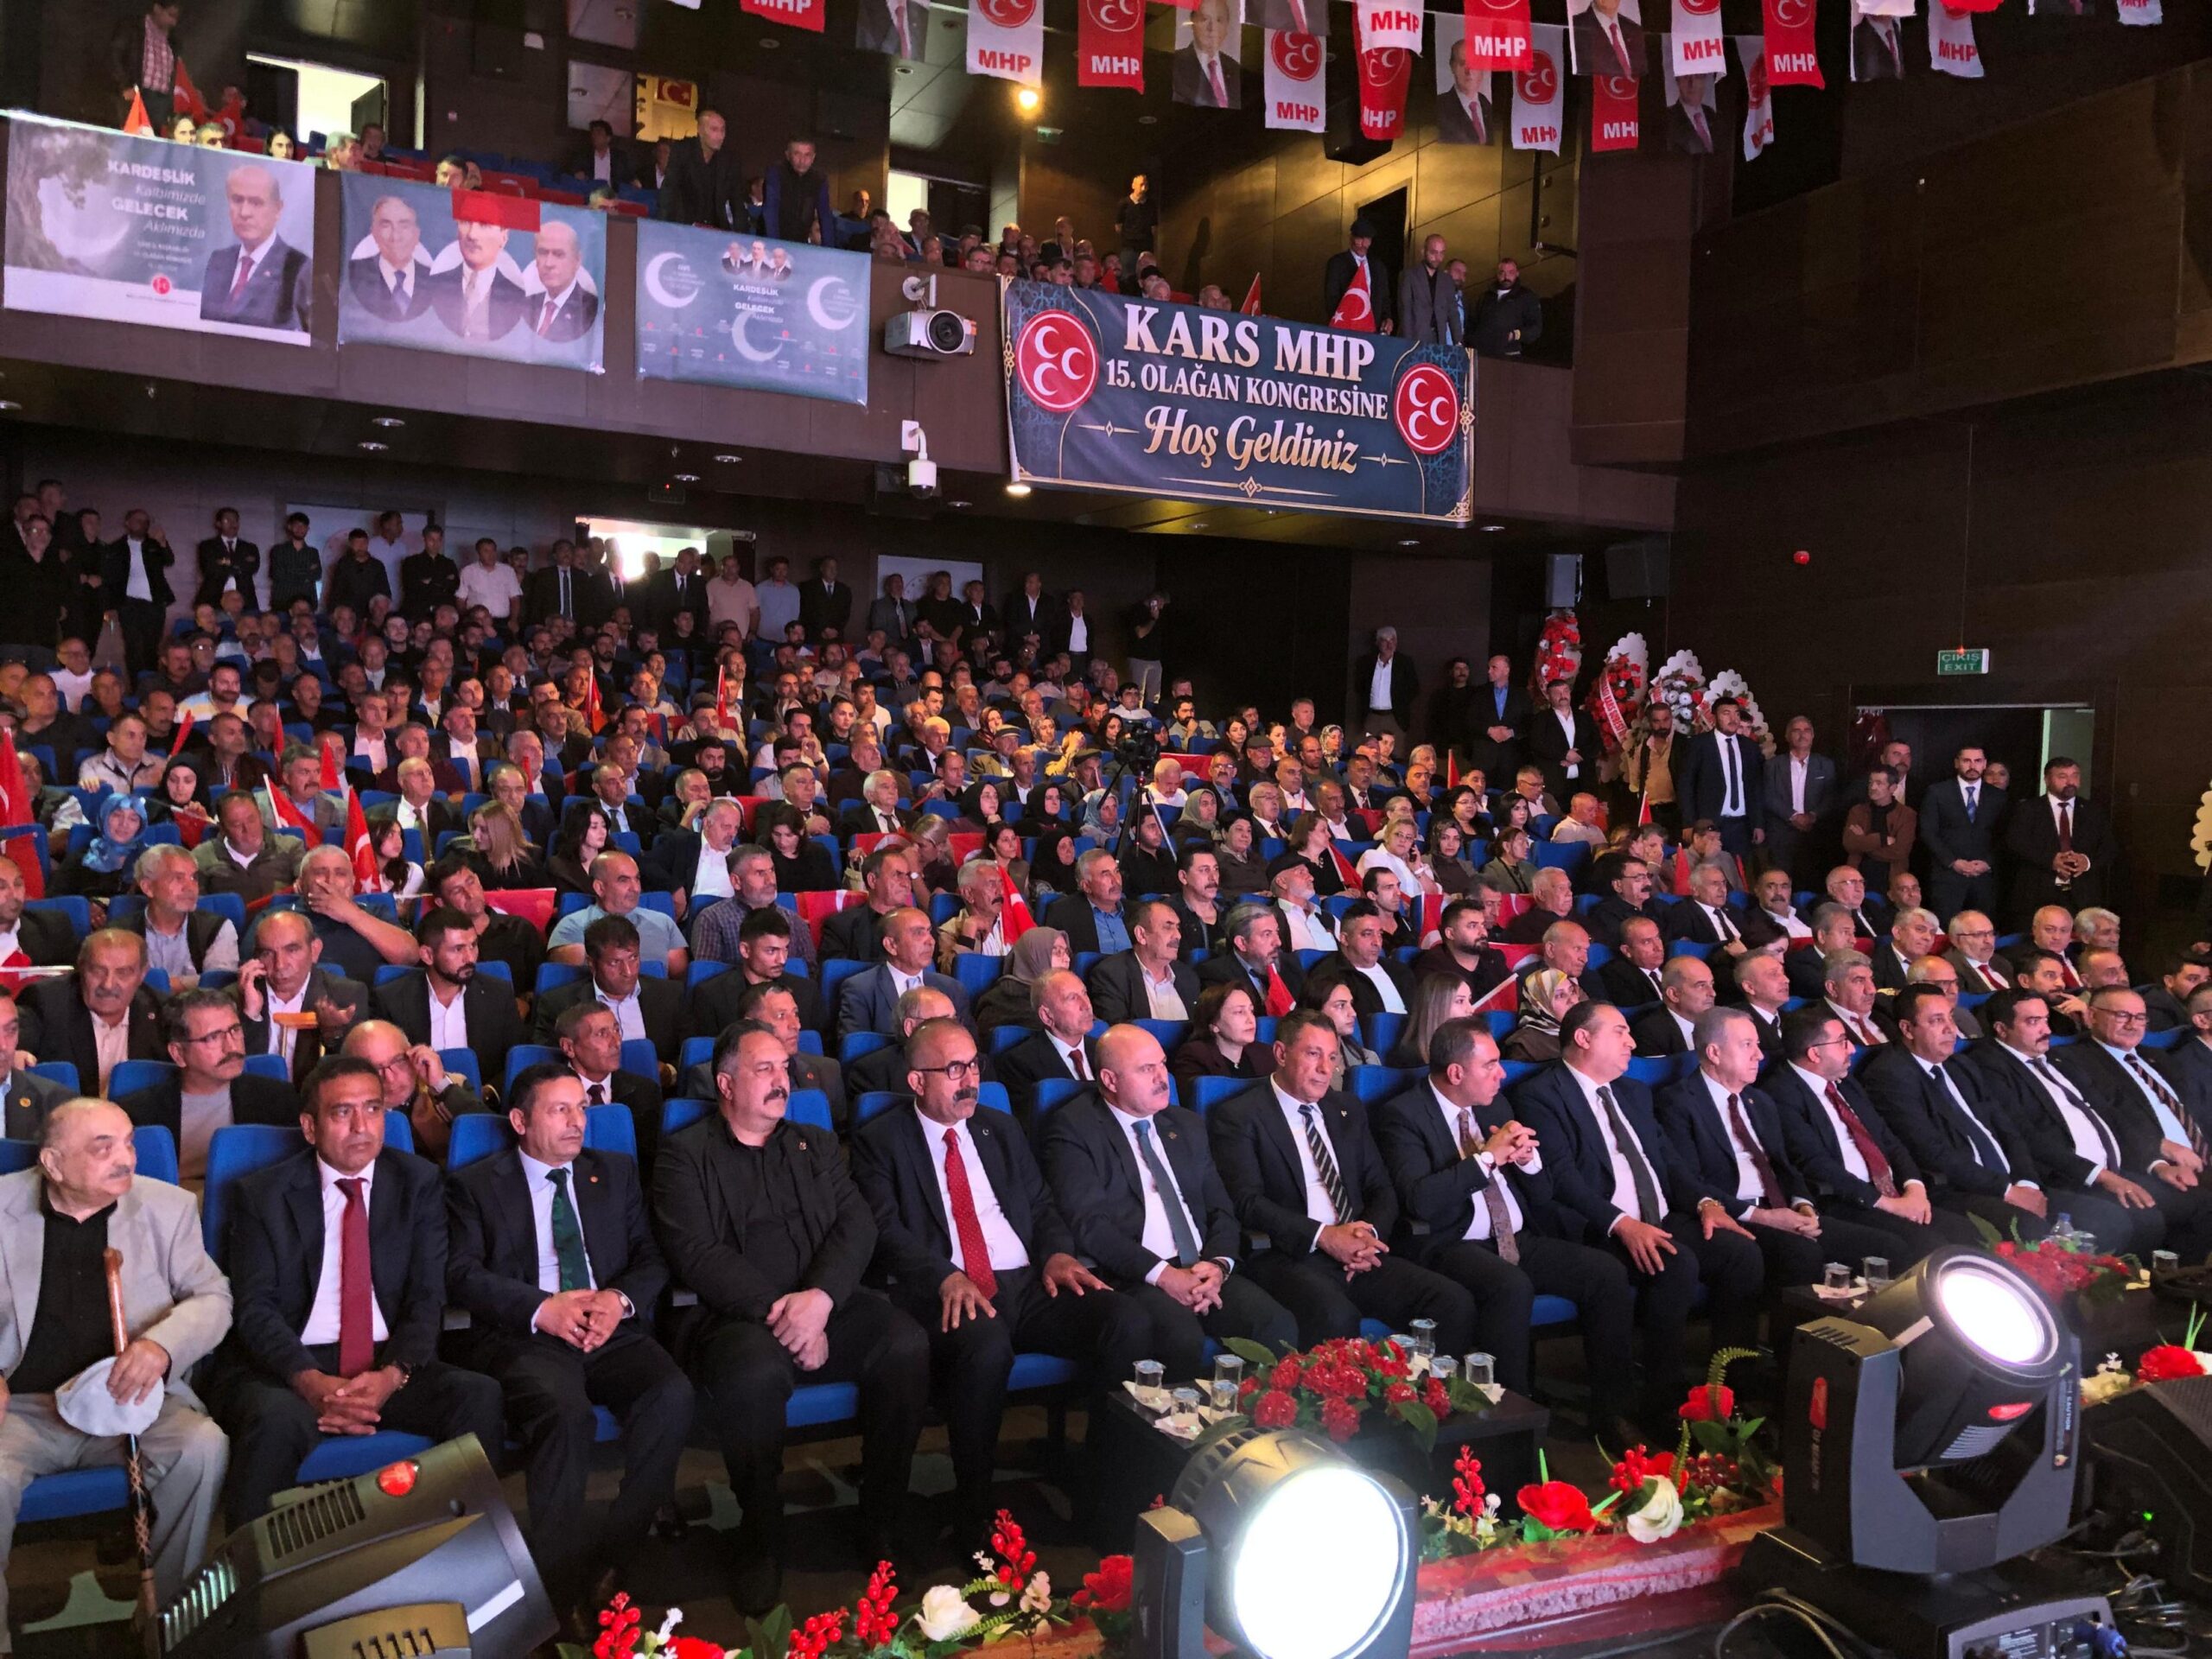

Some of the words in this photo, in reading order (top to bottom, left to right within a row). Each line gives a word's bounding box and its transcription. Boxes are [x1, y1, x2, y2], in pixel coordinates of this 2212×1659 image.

[1370, 10, 1420, 34] MHP
[1474, 35, 1526, 57] MHP
[1683, 38, 1722, 60] MH
[1939, 39, 1977, 61] MHP
[979, 49, 1031, 73] MHP
[1091, 55, 1140, 75] MHP
[1774, 54, 1815, 73] MHP
[1277, 101, 1319, 123] MHP
[1604, 121, 1638, 139] MH
[111, 197, 188, 221] GELECEK
[1123, 303, 1261, 368] KARS
[1274, 326, 1375, 382] MHP
[1106, 358, 1136, 389] 15.
[1141, 363, 1241, 403] OLAĞAN
[1246, 377, 1388, 420] KONGRESİNE
[1143, 405, 1219, 468] Hoş
[1226, 415, 1359, 474] Geldiniz
